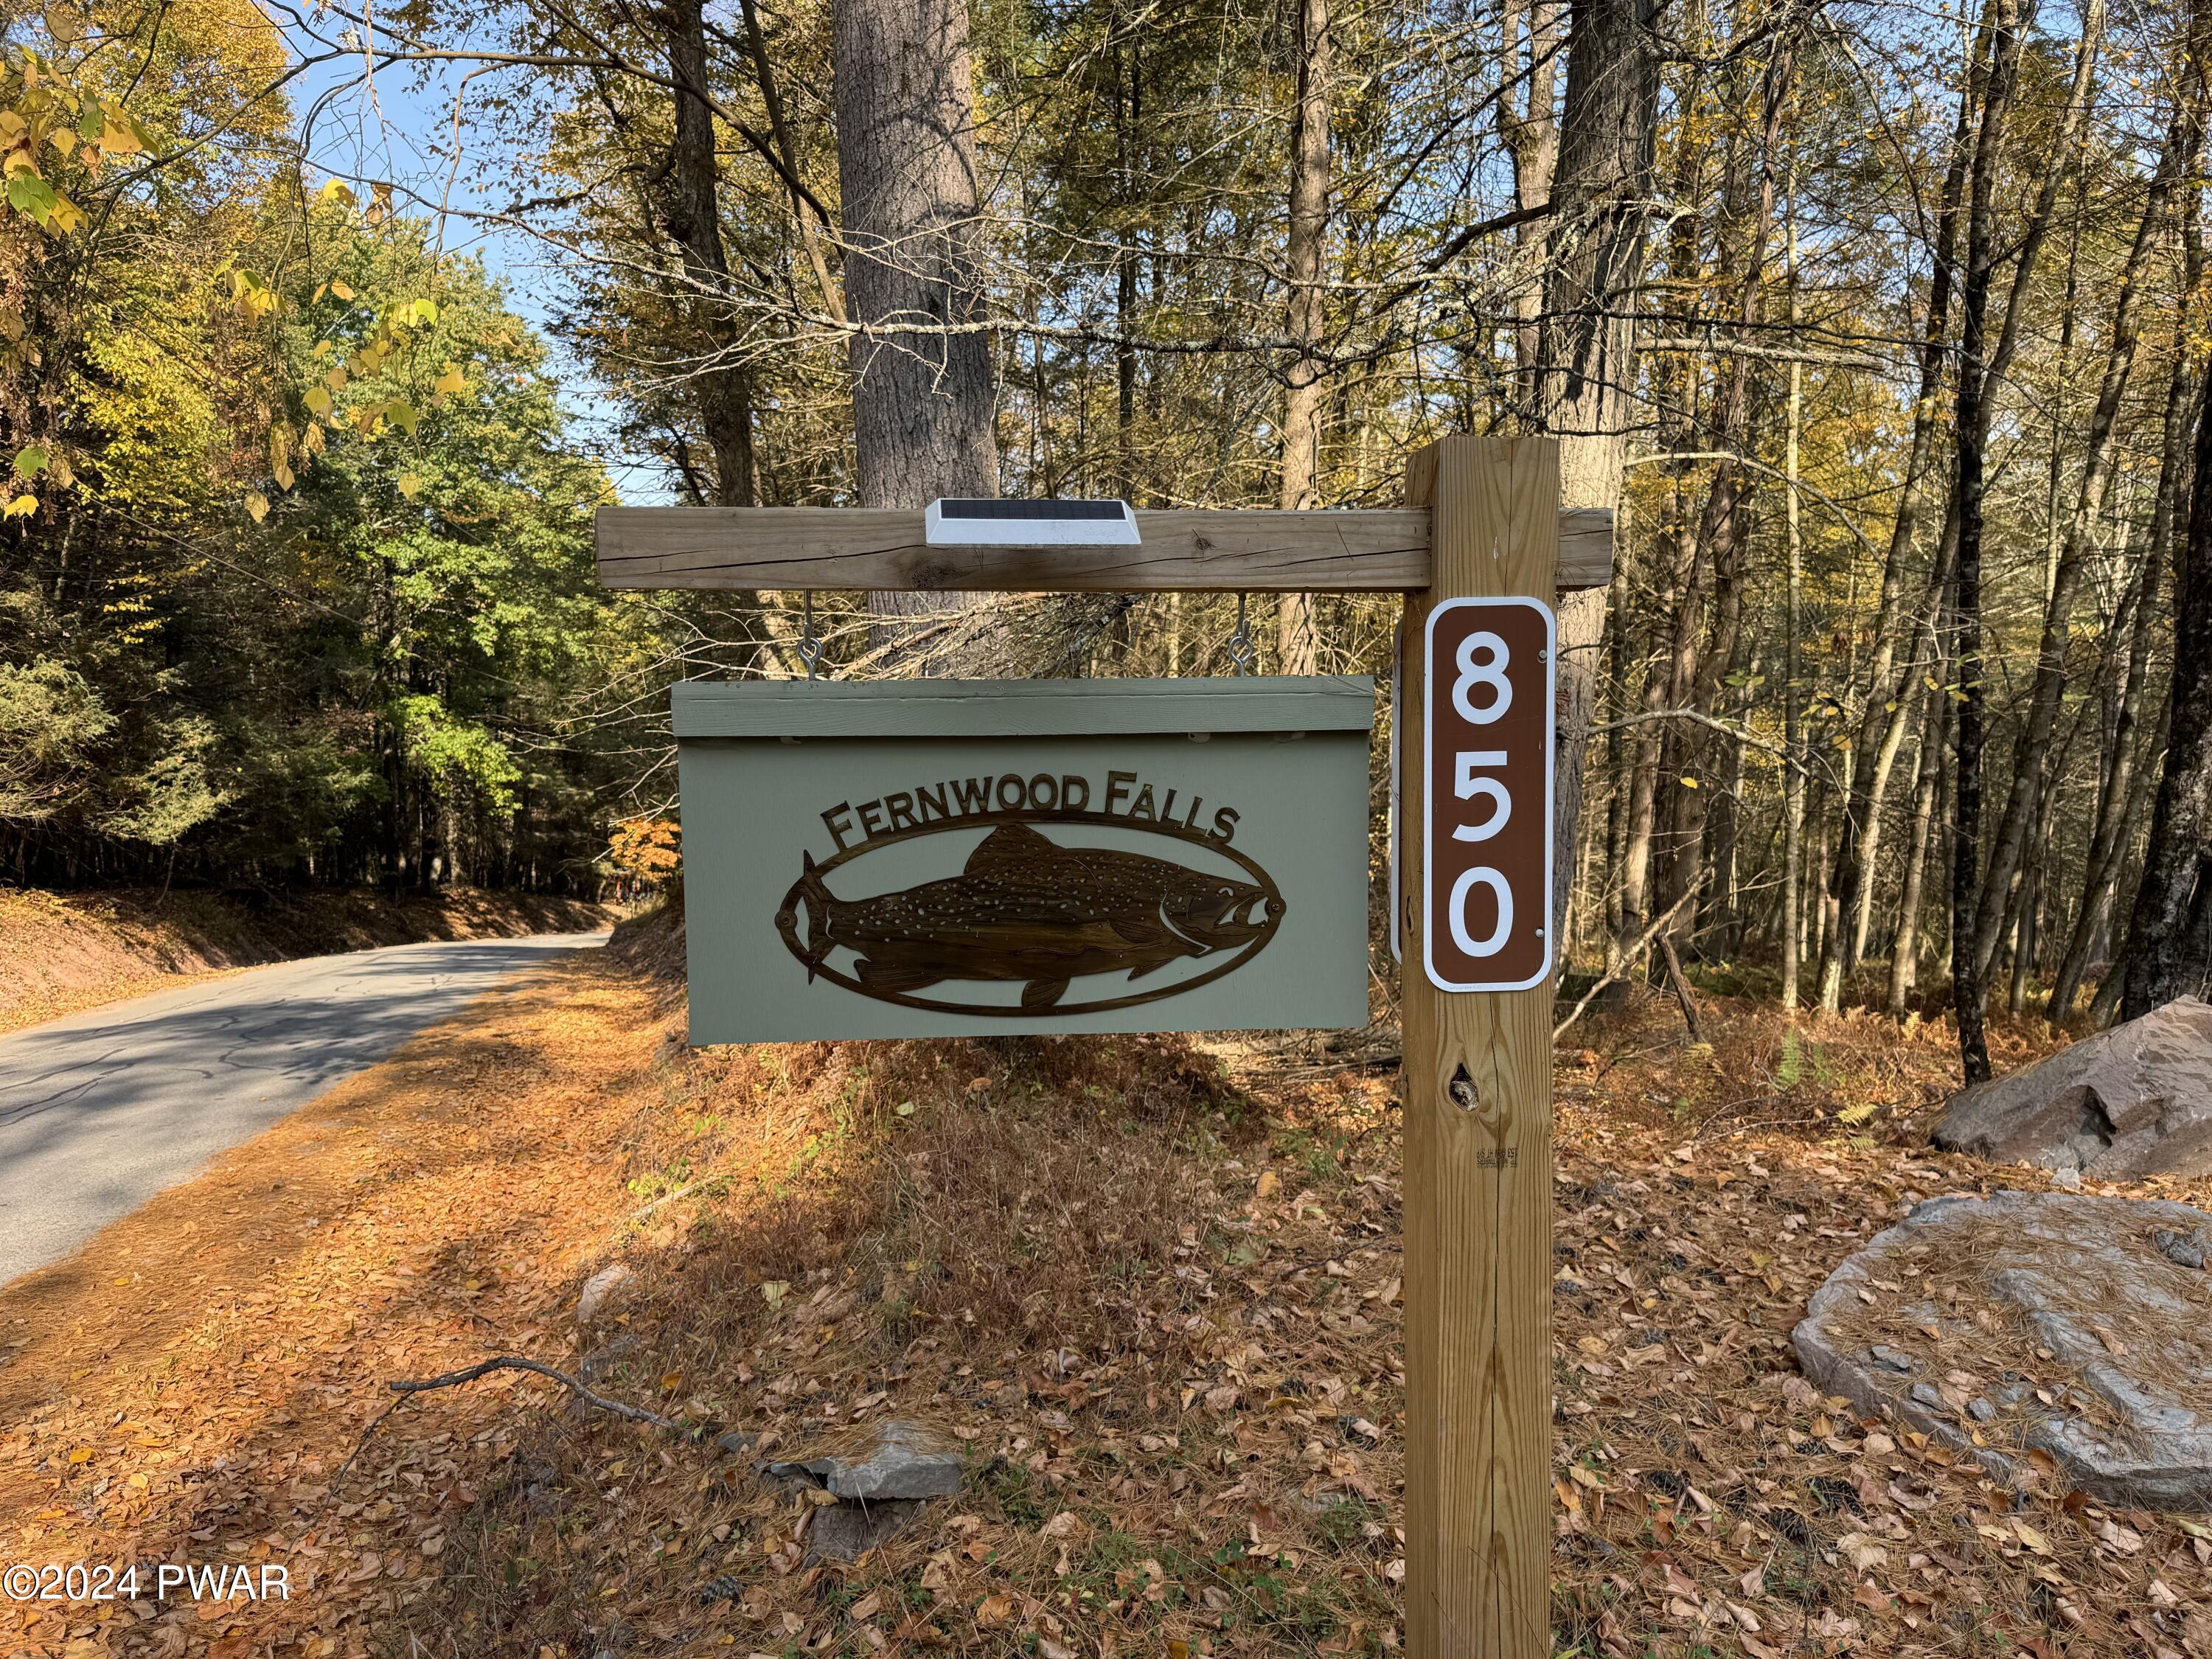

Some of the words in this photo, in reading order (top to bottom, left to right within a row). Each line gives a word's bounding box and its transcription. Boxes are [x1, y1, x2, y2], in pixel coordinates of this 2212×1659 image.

[819, 773, 1090, 852] FERNWOOD
[1107, 770, 1241, 844] FALLS
[1449, 630, 1514, 958] 850
